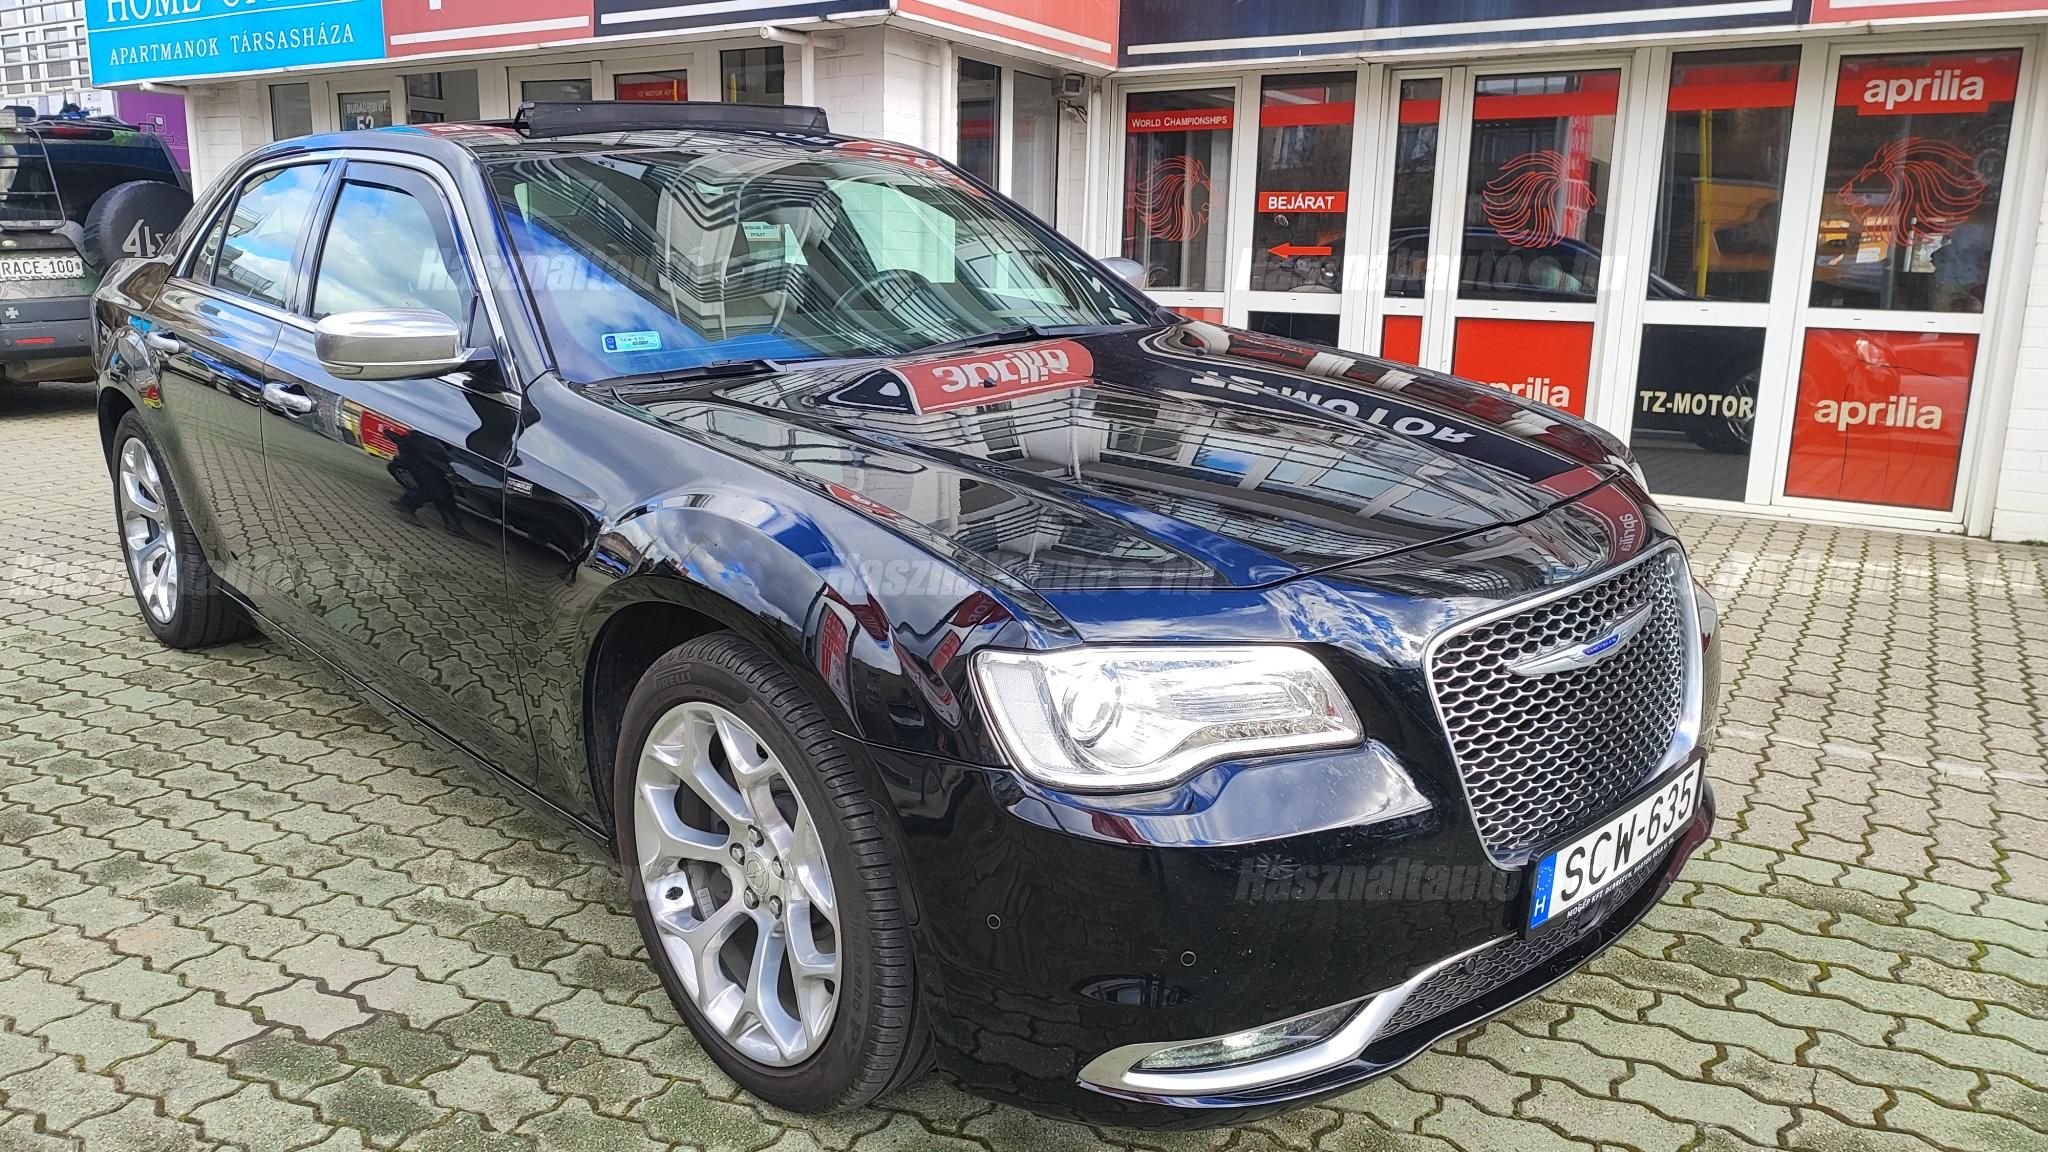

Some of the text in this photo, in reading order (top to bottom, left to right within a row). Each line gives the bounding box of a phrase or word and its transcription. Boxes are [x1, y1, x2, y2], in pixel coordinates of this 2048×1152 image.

[109, 22, 355, 66] APARTMANOK TÁRSASHÁZA
[1863, 69, 1985, 110] aprilia
[1131, 115, 1228, 128] WORLD CHAMPIONSHIPS
[1267, 193, 1335, 209] BEJÁRAT
[2, 260, 75, 275] RACE-100
[1477, 377, 1570, 407] rilia
[1639, 390, 1755, 419] TZ-MOTOR
[1815, 395, 1943, 431] aprilia
[1561, 770, 1694, 902] SCW-635
[1534, 895, 1547, 917] H
